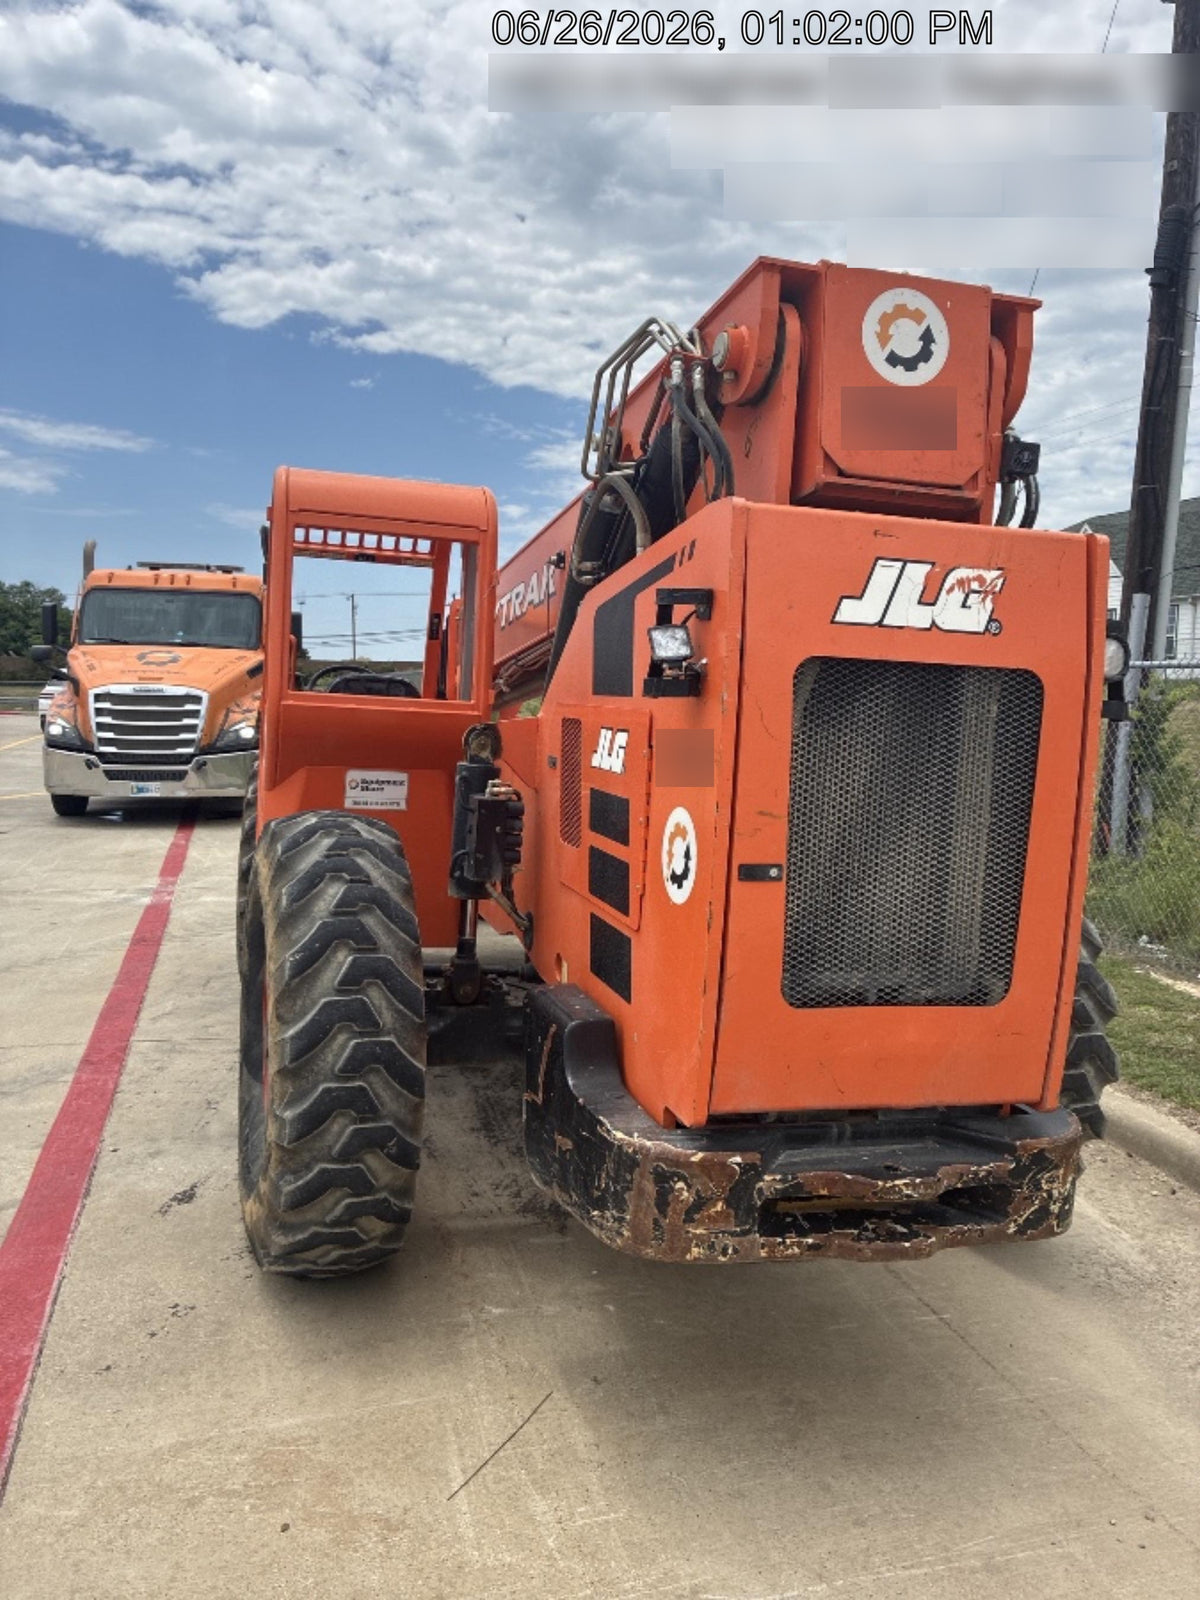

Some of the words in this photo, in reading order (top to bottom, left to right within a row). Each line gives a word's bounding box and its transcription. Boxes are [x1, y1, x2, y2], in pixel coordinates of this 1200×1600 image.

[495, 564, 556, 630] TRAK
[830, 556, 1007, 635] JLG
[590, 726, 629, 775] JLG
